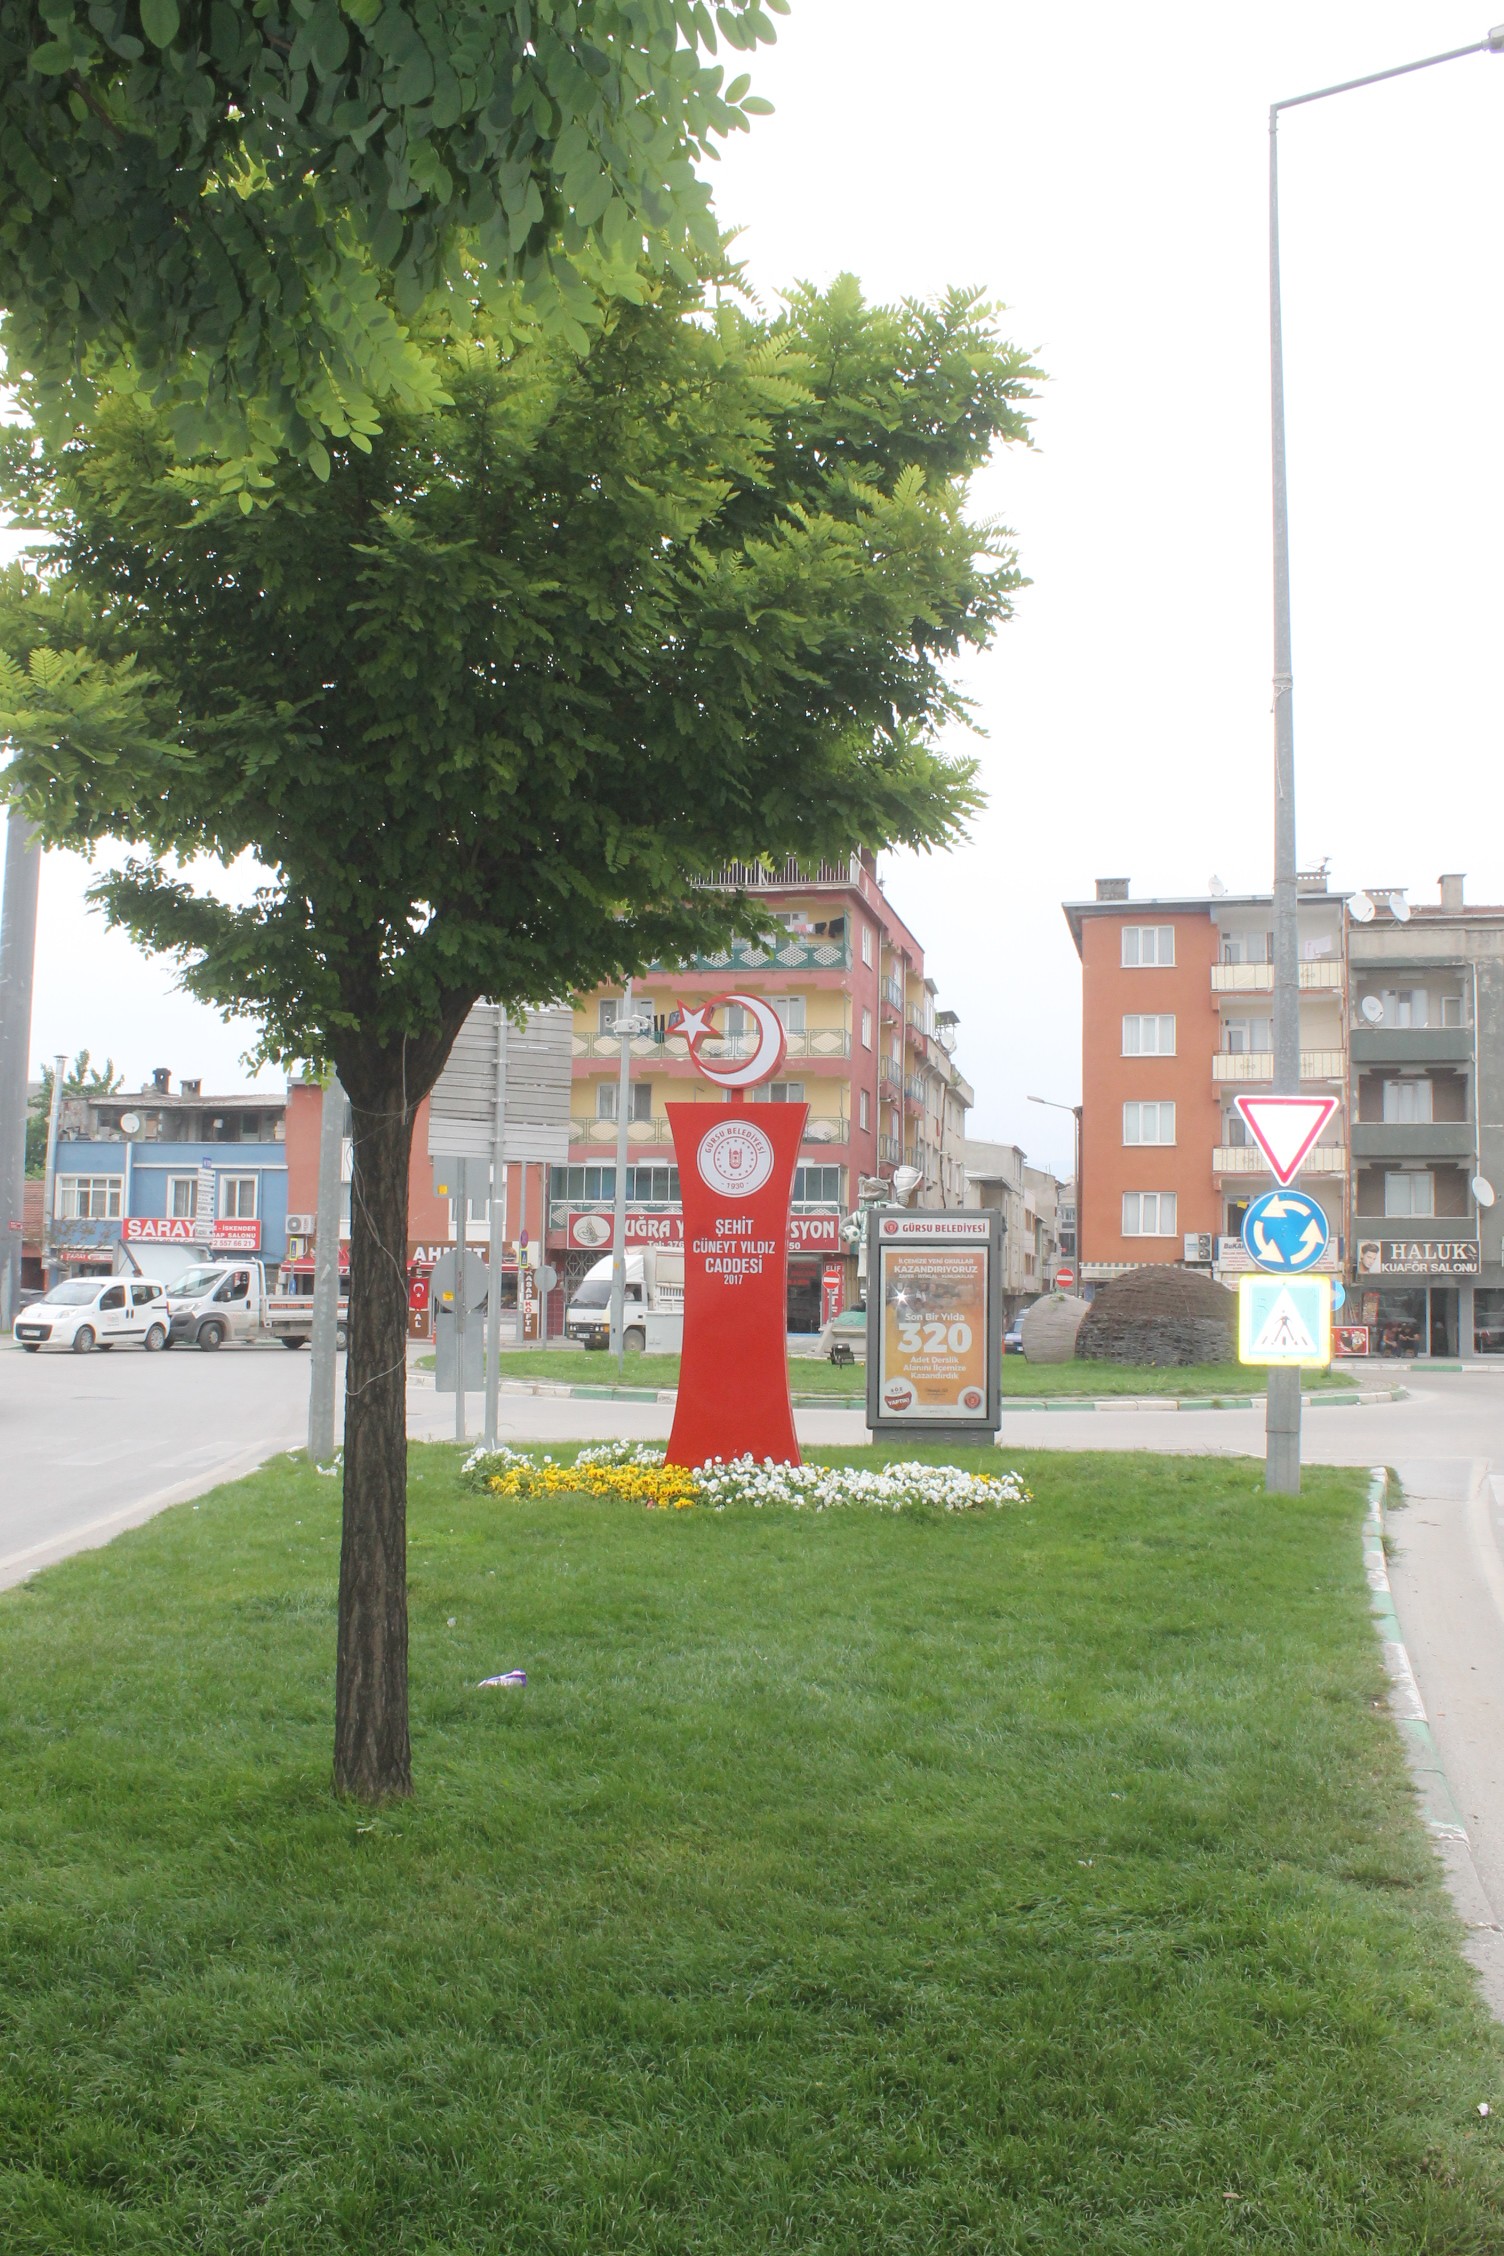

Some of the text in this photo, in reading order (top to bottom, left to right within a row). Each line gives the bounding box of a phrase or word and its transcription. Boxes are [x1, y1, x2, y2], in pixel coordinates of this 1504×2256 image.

[705, 1127, 766, 1154] GÜRSU BELEDİYESİ
[727, 1182, 744, 1190] 1930
[127, 1219, 197, 1238] SARAY
[624, 1215, 671, 1239] UĞRA
[715, 1215, 754, 1237] ŞEHİT
[902, 1223, 986, 1233] GÜRSU BELEDİYESİ
[692, 1237, 776, 1254] CÜNEYT YILDIZ
[1390, 1243, 1468, 1260] HALUK
[705, 1254, 763, 1274] CADDESİ
[894, 1265, 978, 1273] KAZANDIRIYORUZ
[1381, 1261, 1477, 1273] KUAFÖR SALONU
[723, 1274, 743, 1285] 2017
[905, 1313, 965, 1321] Son Bir Yılda
[897, 1322, 972, 1353] 320
[910, 1356, 929, 1364] Adet
